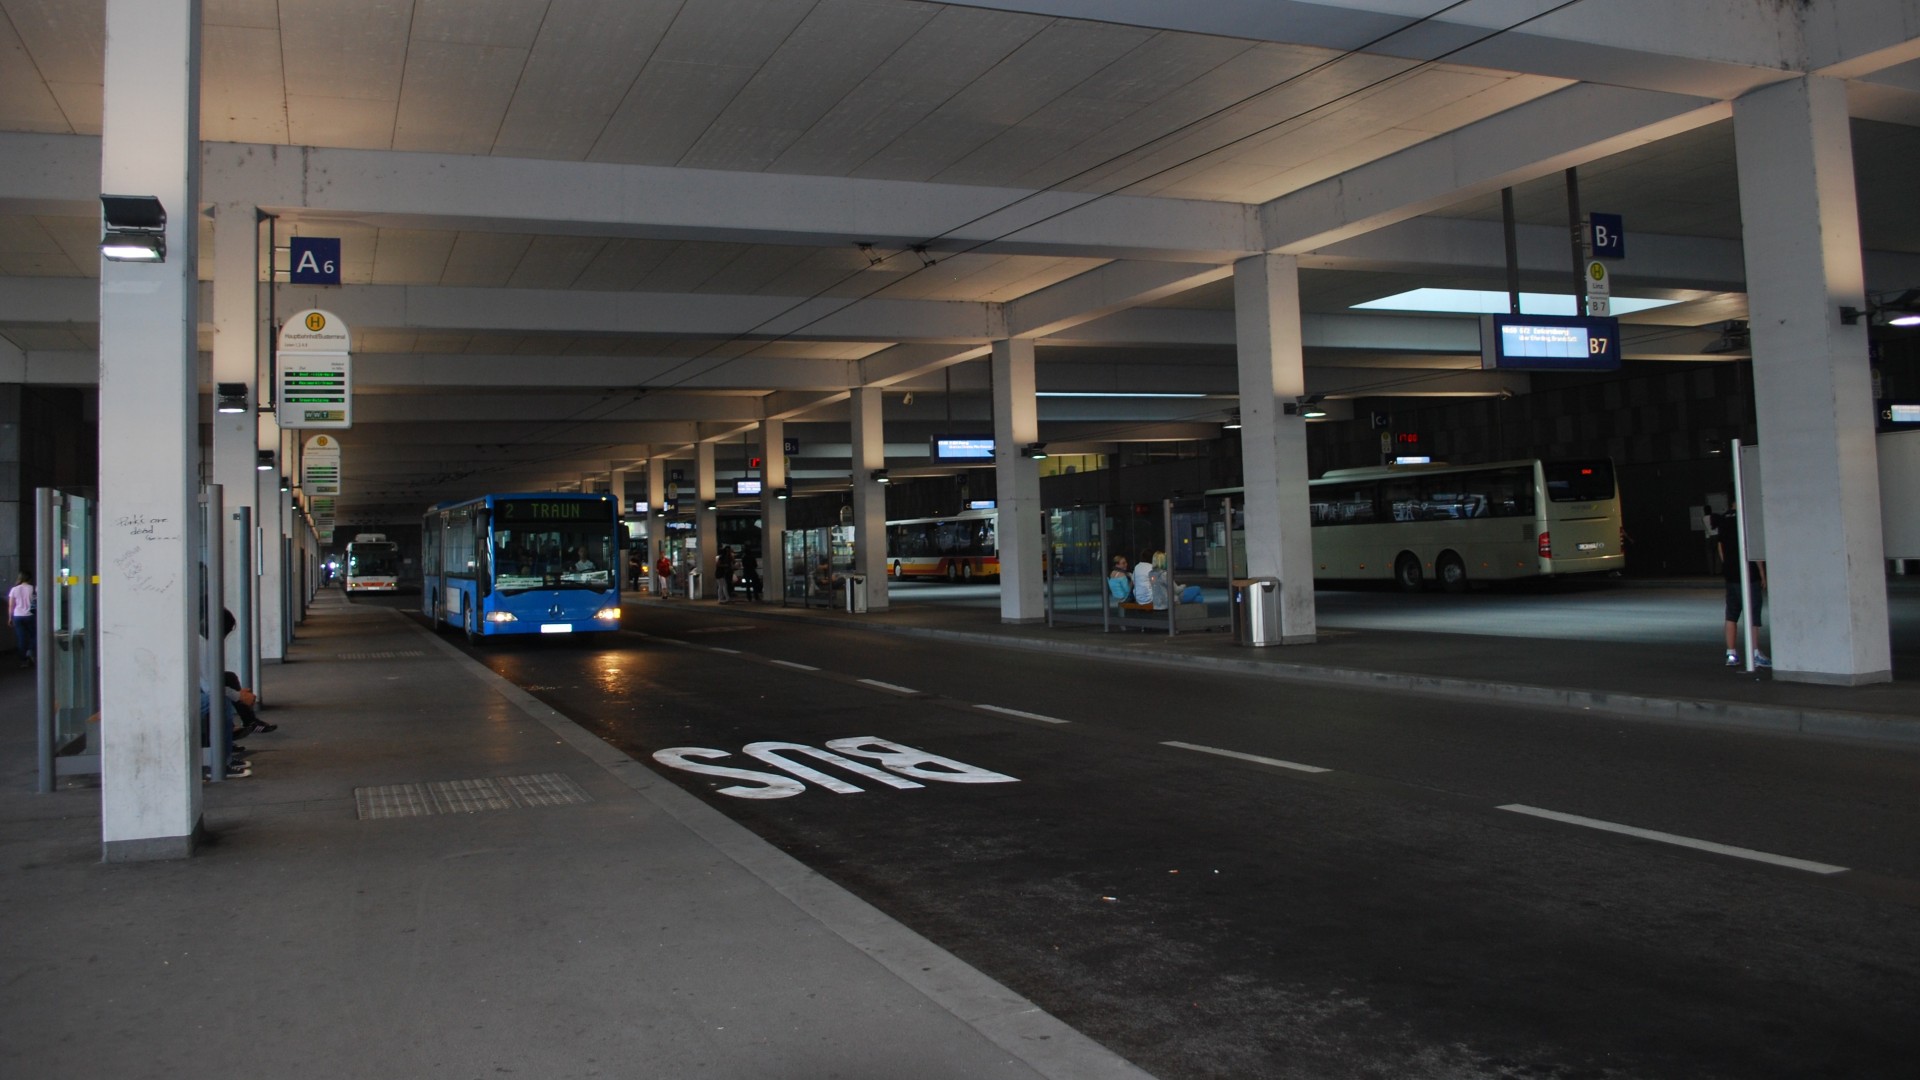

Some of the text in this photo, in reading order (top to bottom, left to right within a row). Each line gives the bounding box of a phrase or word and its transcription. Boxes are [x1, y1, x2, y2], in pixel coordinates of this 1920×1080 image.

[1589, 338, 1608, 354] B7
[505, 503, 581, 518] 2 TRAUN
[652, 735, 1022, 800] BUS
